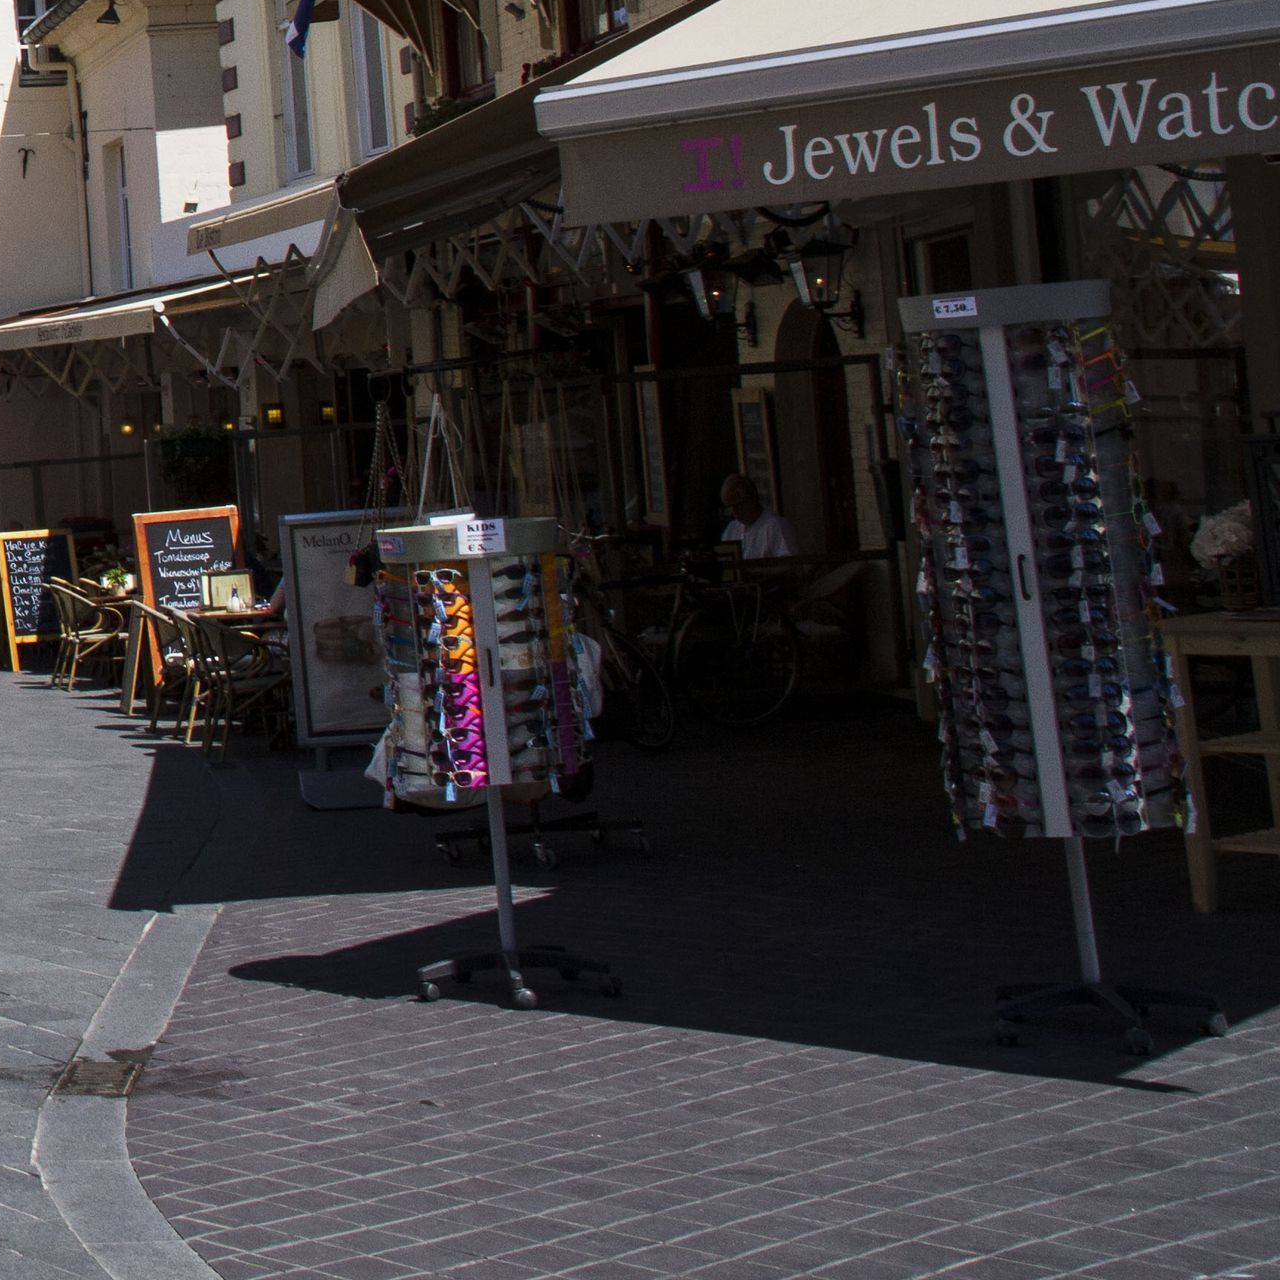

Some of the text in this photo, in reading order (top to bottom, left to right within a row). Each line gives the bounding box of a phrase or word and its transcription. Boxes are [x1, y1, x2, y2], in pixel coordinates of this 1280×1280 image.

[763, 103, 982, 185] Jewels
[1003, 93, 1059, 157] &
[1081, 71, 1280, 147] Watc
[165, 528, 214, 547] Menus
